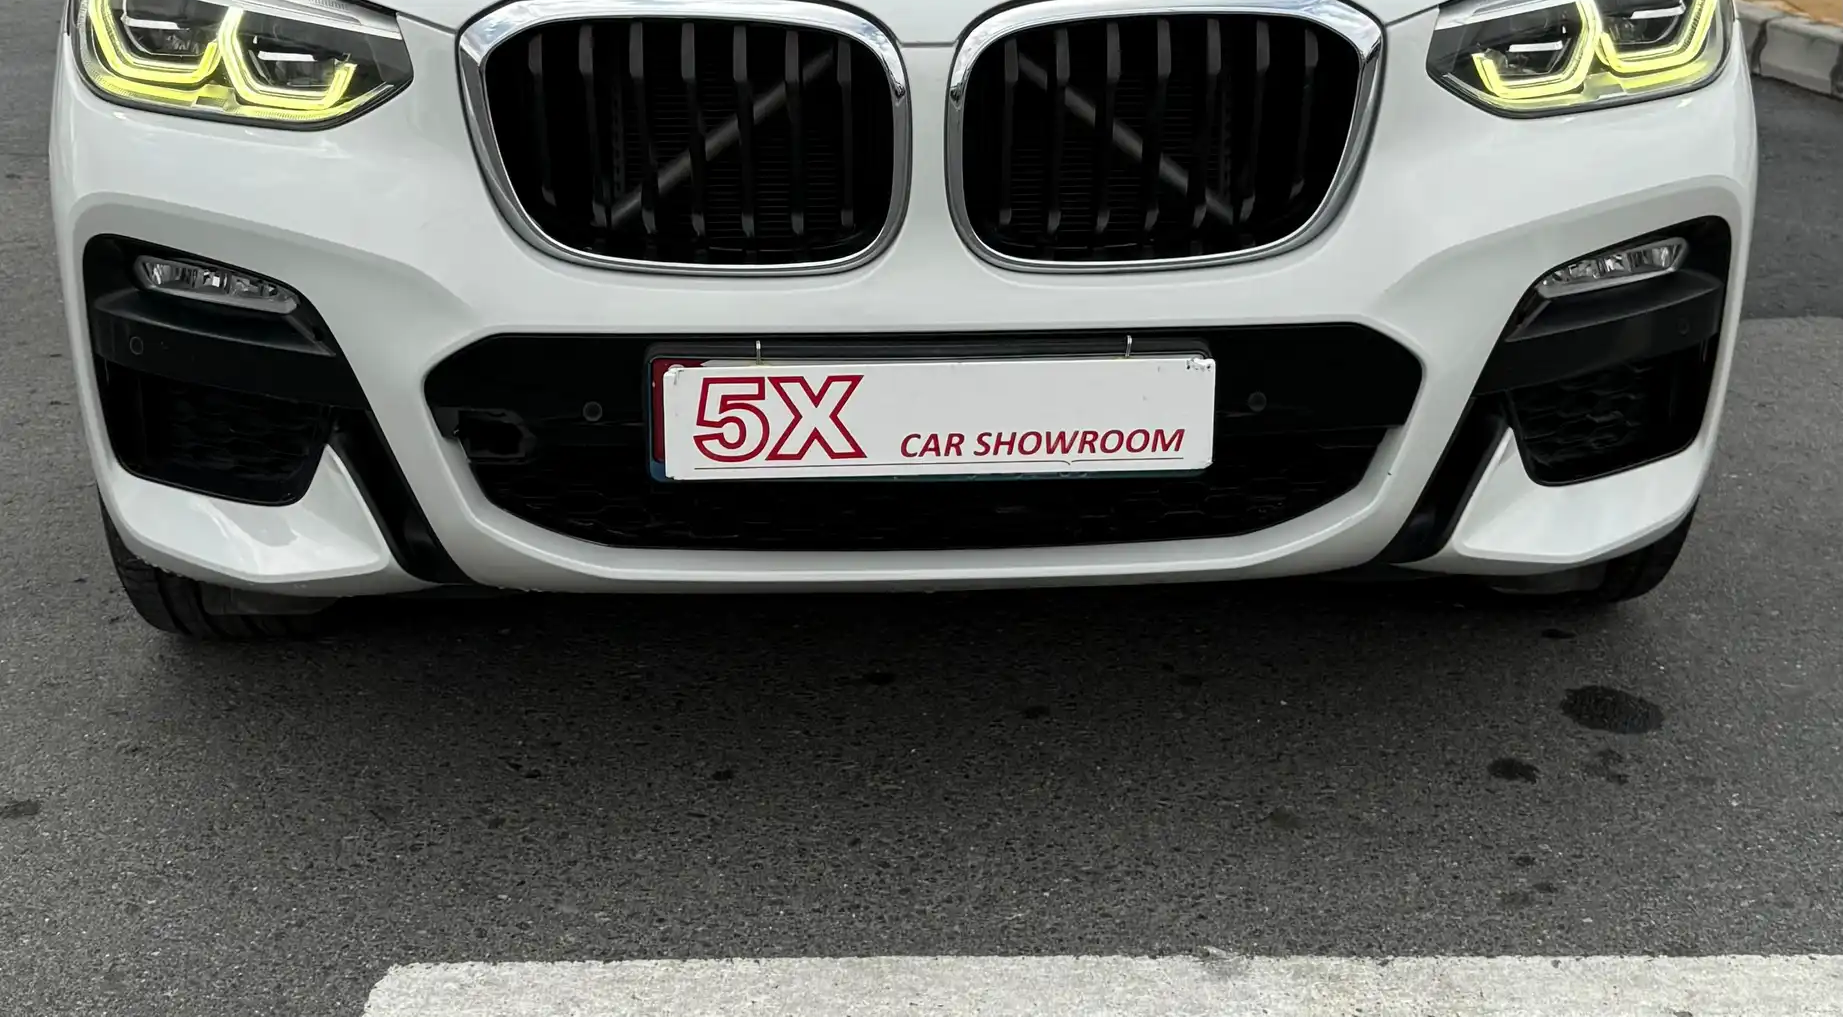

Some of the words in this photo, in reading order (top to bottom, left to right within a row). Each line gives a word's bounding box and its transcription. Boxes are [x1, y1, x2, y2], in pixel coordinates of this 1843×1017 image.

[693, 374, 867, 462] 5X
[900, 432, 965, 458] CAR
[973, 428, 1185, 456] SHOWROOM
